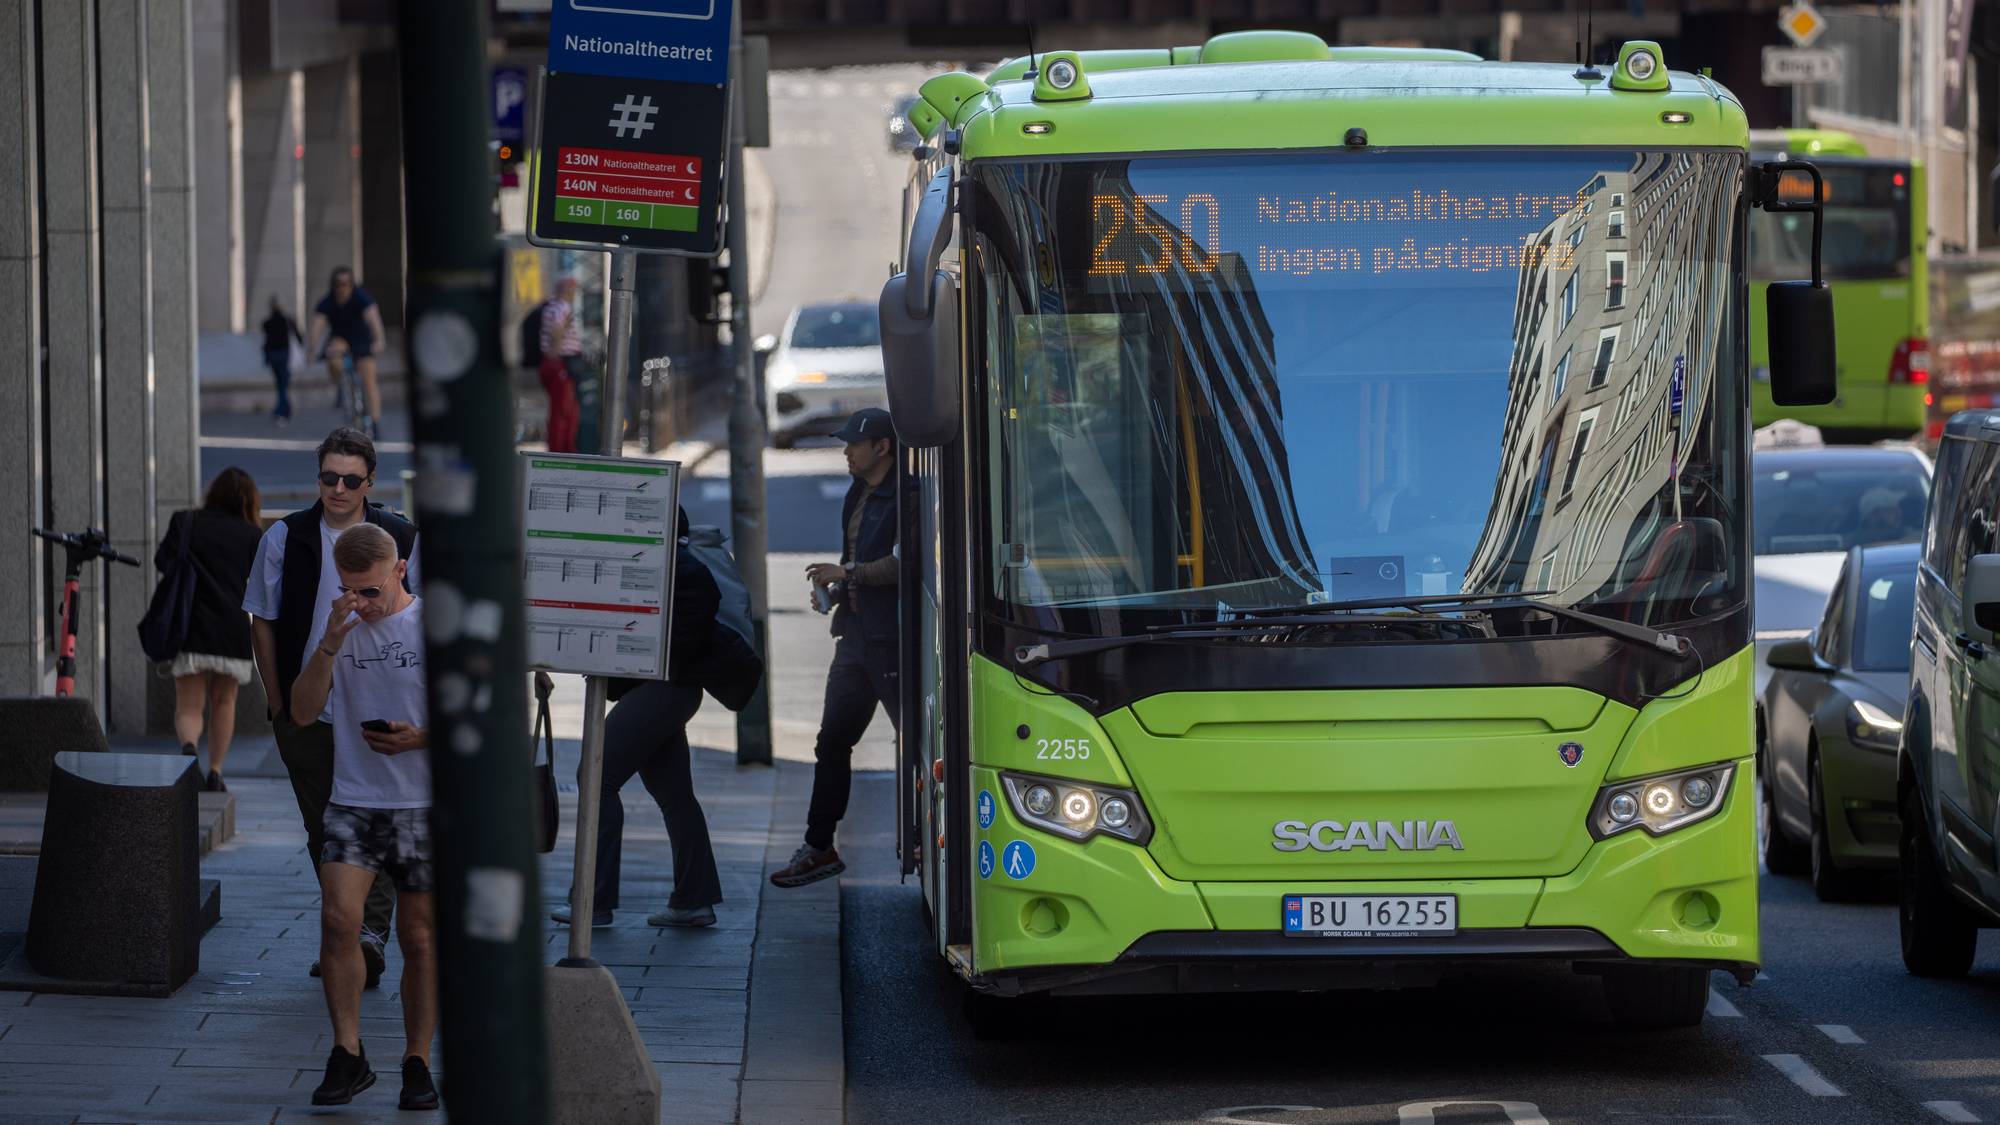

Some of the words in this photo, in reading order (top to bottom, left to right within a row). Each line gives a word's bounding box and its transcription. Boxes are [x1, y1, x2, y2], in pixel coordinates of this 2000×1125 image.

[564, 34, 713, 62] Nationaltheatret
[565, 153, 599, 167] 130N
[603, 158, 676, 174] Nationaltheatret
[563, 179, 597, 193] 140N
[601, 184, 674, 199] Nationaltheatret
[567, 205, 592, 217] 150
[616, 208, 640, 221] 160
[1257, 189, 1588, 224] Nationaltheatret
[1088, 193, 1220, 275] 250
[1257, 243, 1362, 276] Ingen
[1036, 738, 1090, 760] 2255
[1271, 819, 1464, 852] SCANIA
[1290, 918, 1298, 926] N
[1310, 900, 1347, 927] BU
[1362, 900, 1448, 926] 16255
